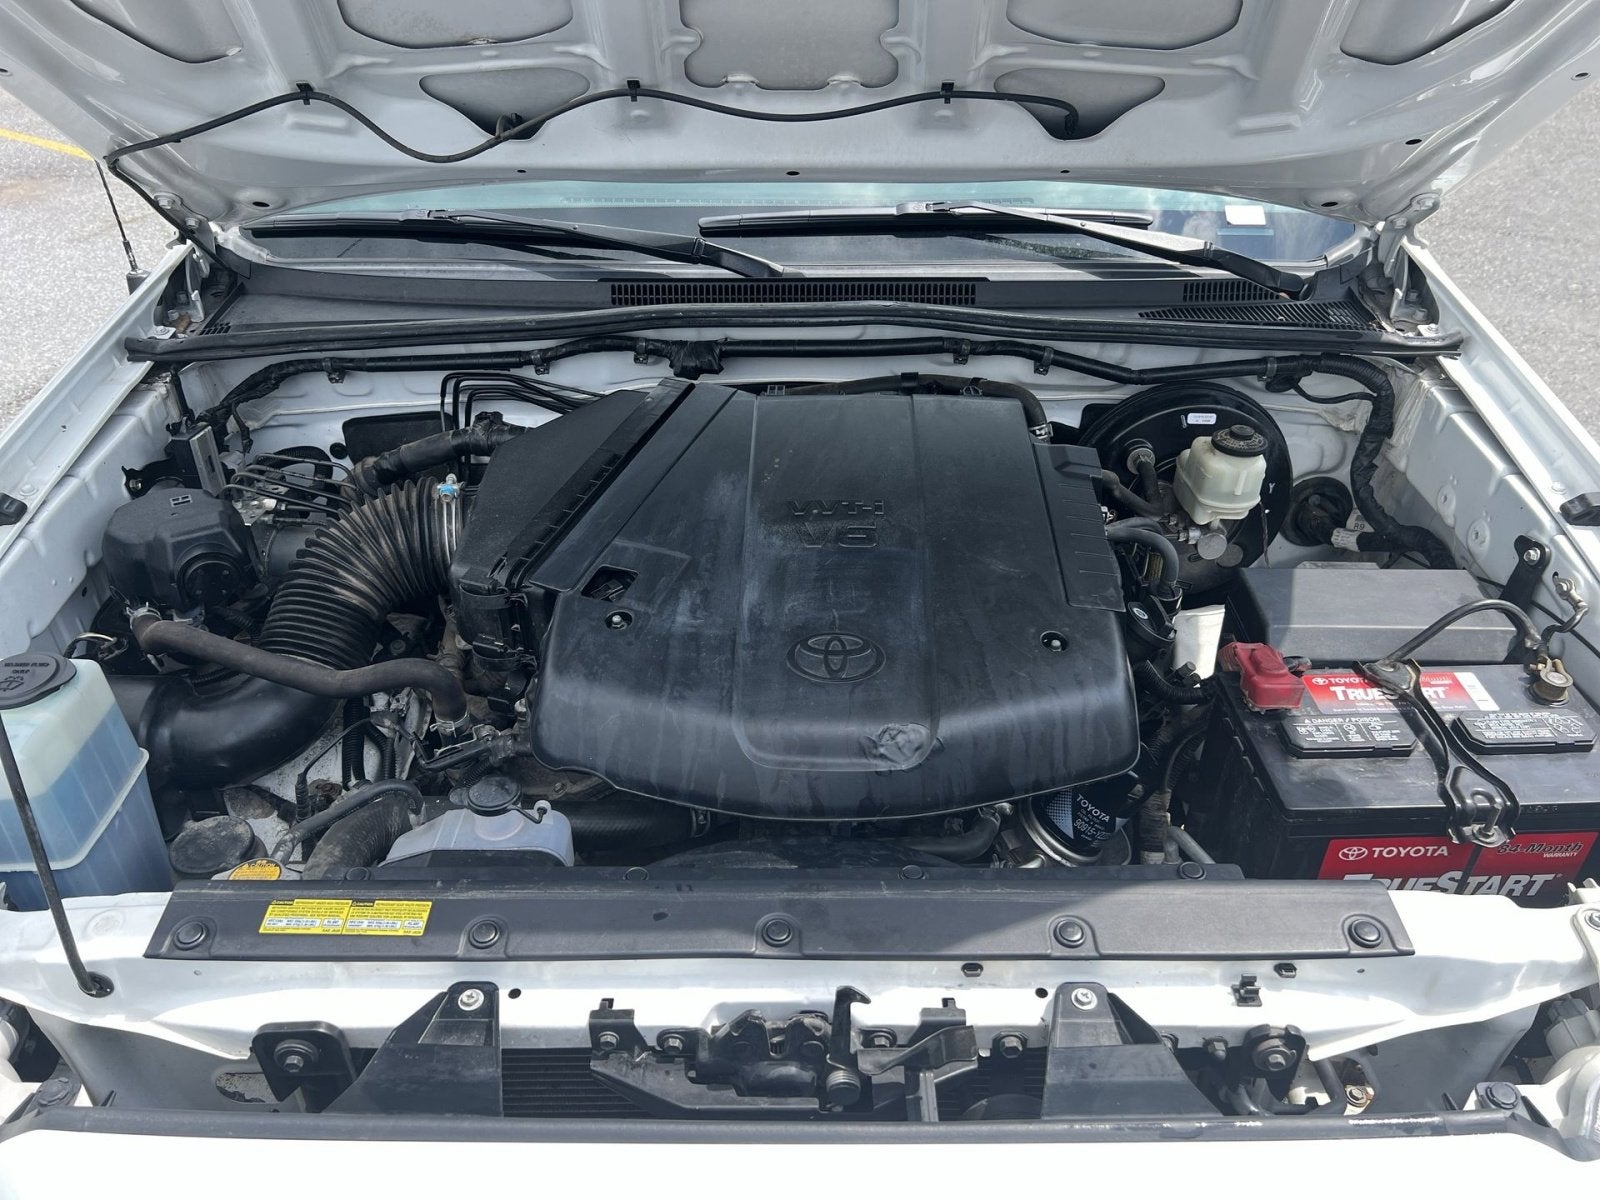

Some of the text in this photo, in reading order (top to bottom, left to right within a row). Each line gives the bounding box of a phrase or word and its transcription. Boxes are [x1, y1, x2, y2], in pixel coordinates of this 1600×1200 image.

[795, 521, 878, 548] V6
[1077, 794, 1110, 822] TOYOTA
[1371, 846, 1449, 858] TOYOTA
